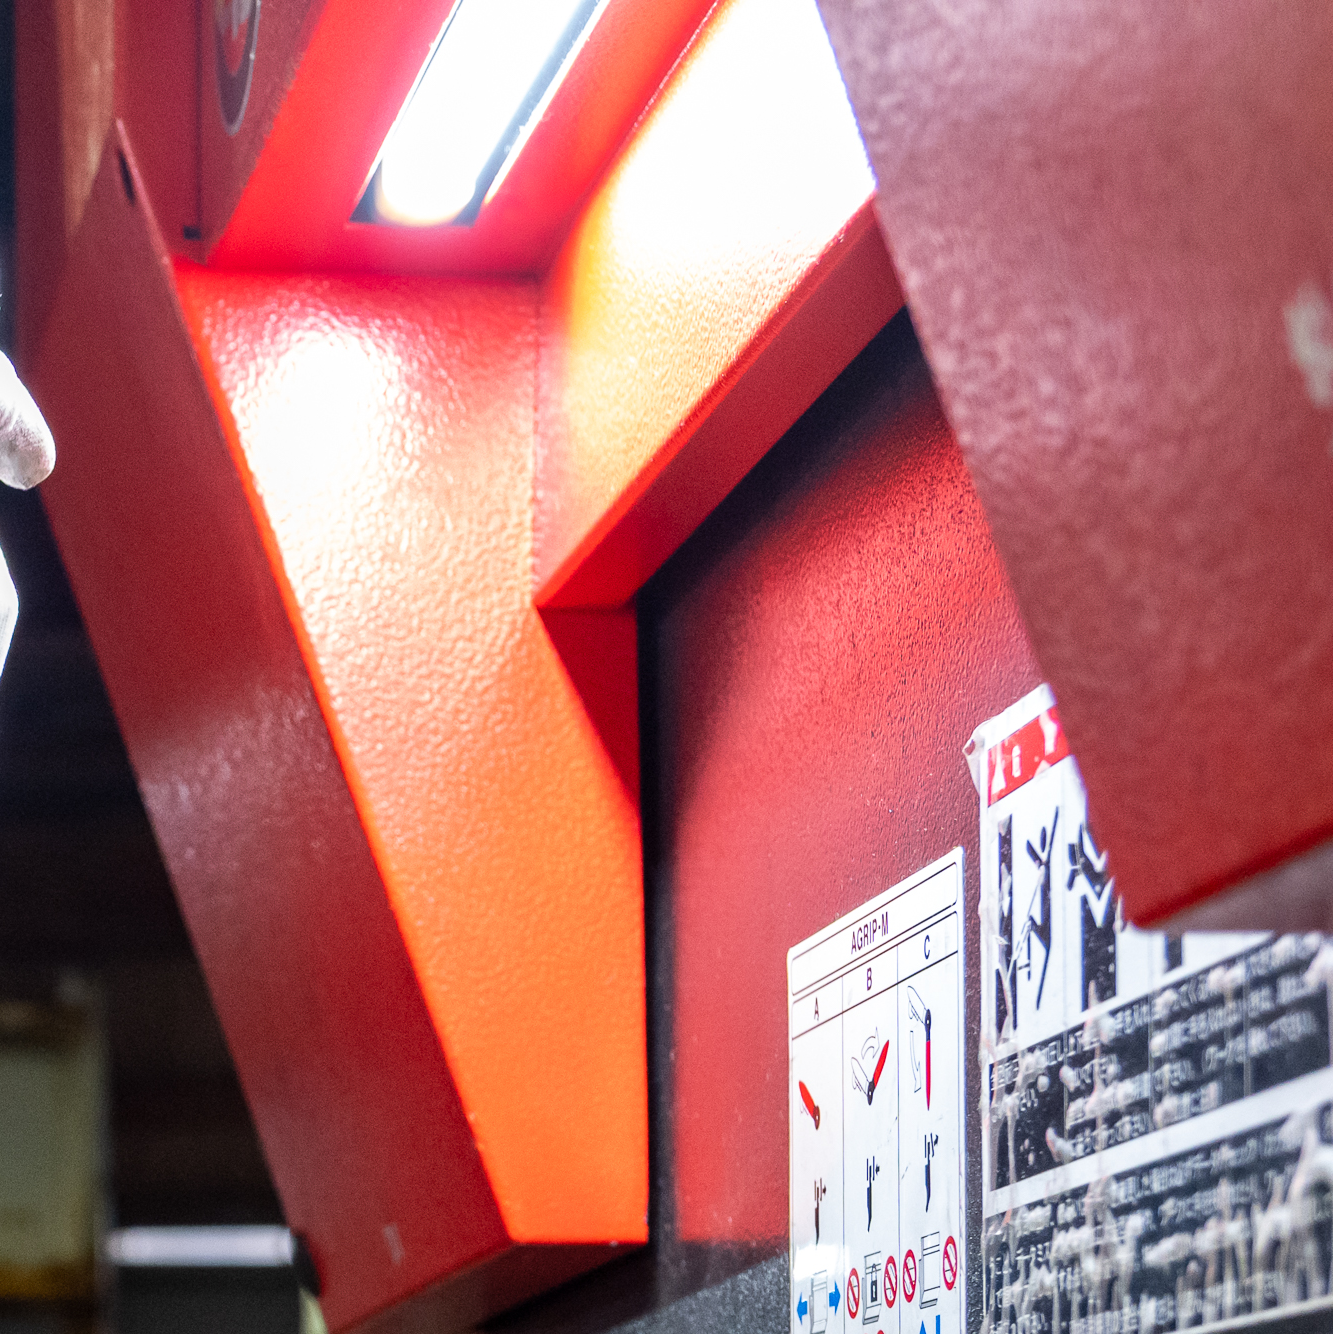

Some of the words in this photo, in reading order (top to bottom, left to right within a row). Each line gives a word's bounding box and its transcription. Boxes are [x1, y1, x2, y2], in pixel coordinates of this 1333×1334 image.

[851, 911, 889, 954] AGRIP-M
[814, 997, 820, 1021] A
[866, 967, 872, 991] B
[923, 935, 930, 959] C
